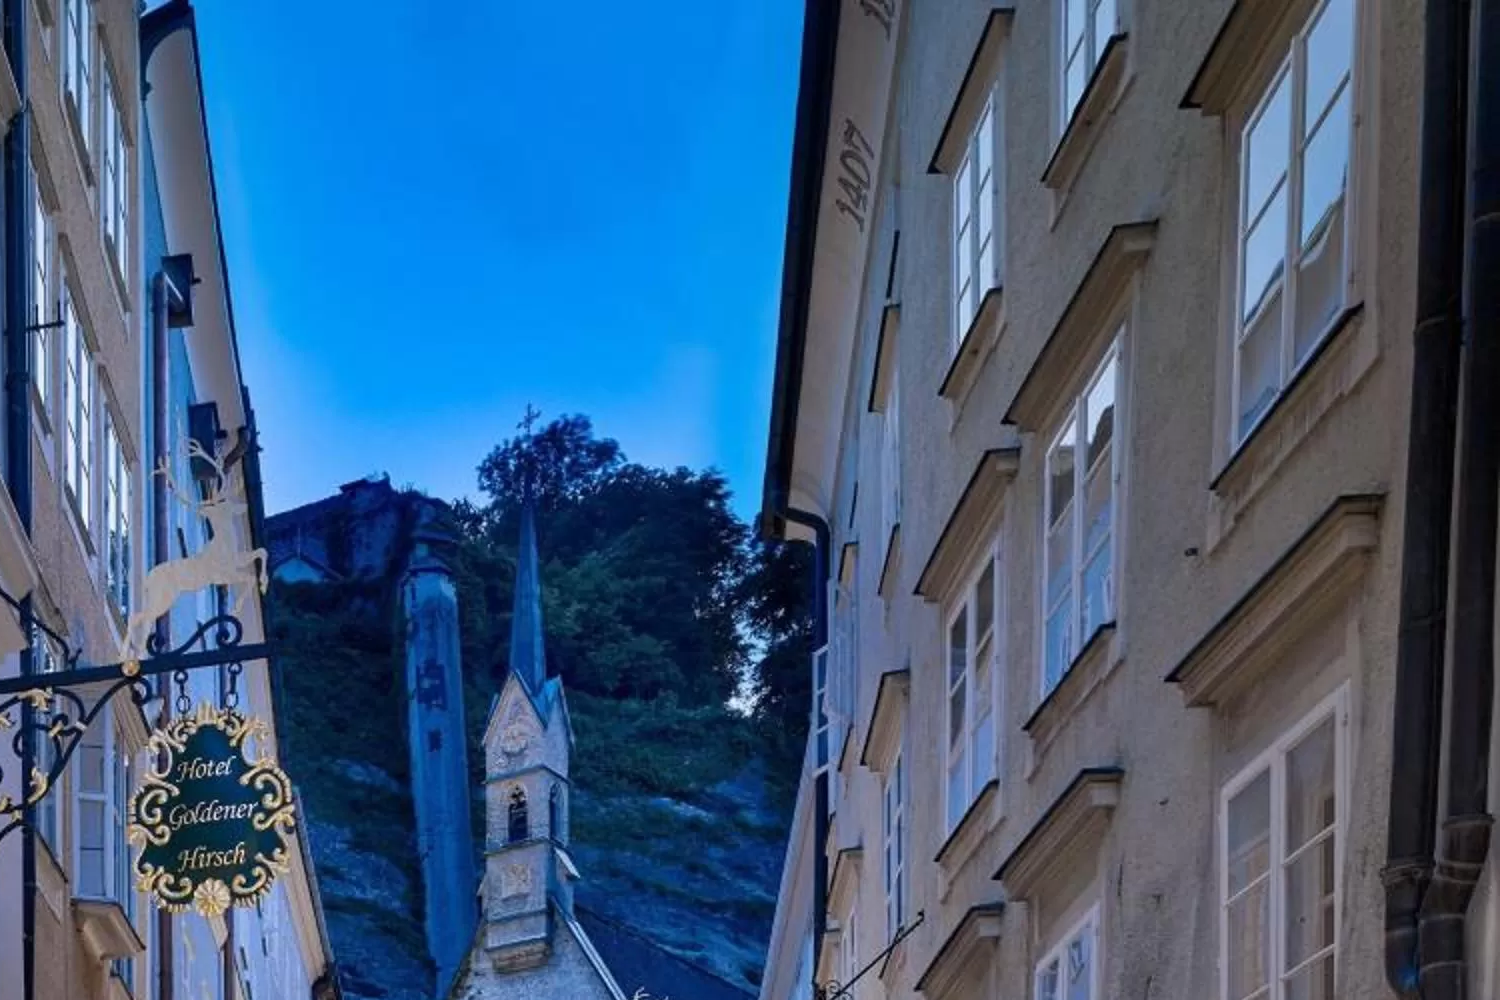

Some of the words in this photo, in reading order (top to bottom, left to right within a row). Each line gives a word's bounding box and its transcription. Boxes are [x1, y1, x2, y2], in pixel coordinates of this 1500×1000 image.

[175, 755, 236, 783] Hotel
[169, 799, 258, 831] Goldener
[177, 842, 246, 873] Hirsch
